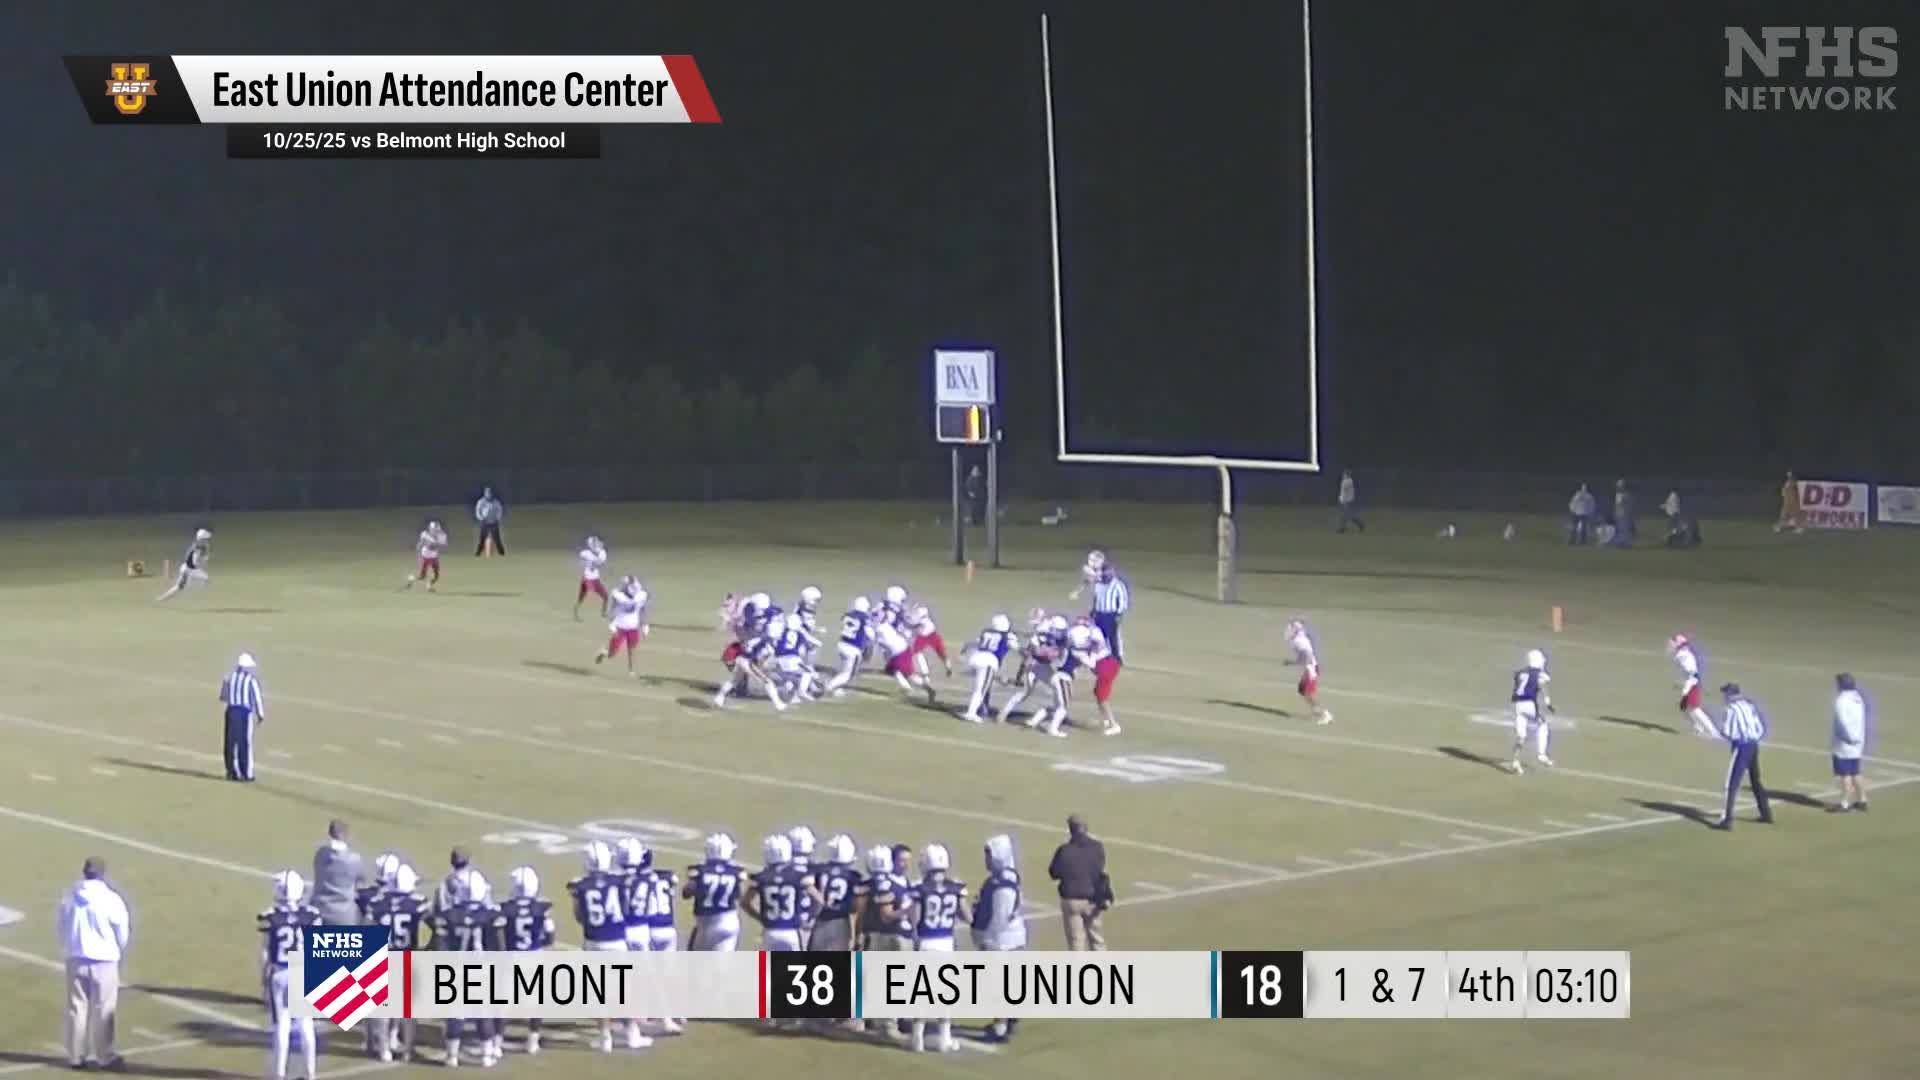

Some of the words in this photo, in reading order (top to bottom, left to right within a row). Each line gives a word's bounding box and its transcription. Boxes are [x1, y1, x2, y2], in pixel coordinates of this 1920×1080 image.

[946, 364, 979, 390] BNA
[585, 886, 624, 926] 64
[703, 873, 736, 908] 77
[764, 885, 796, 920] 53
[455, 927, 482, 951] 71
[515, 916, 534, 950] 5
